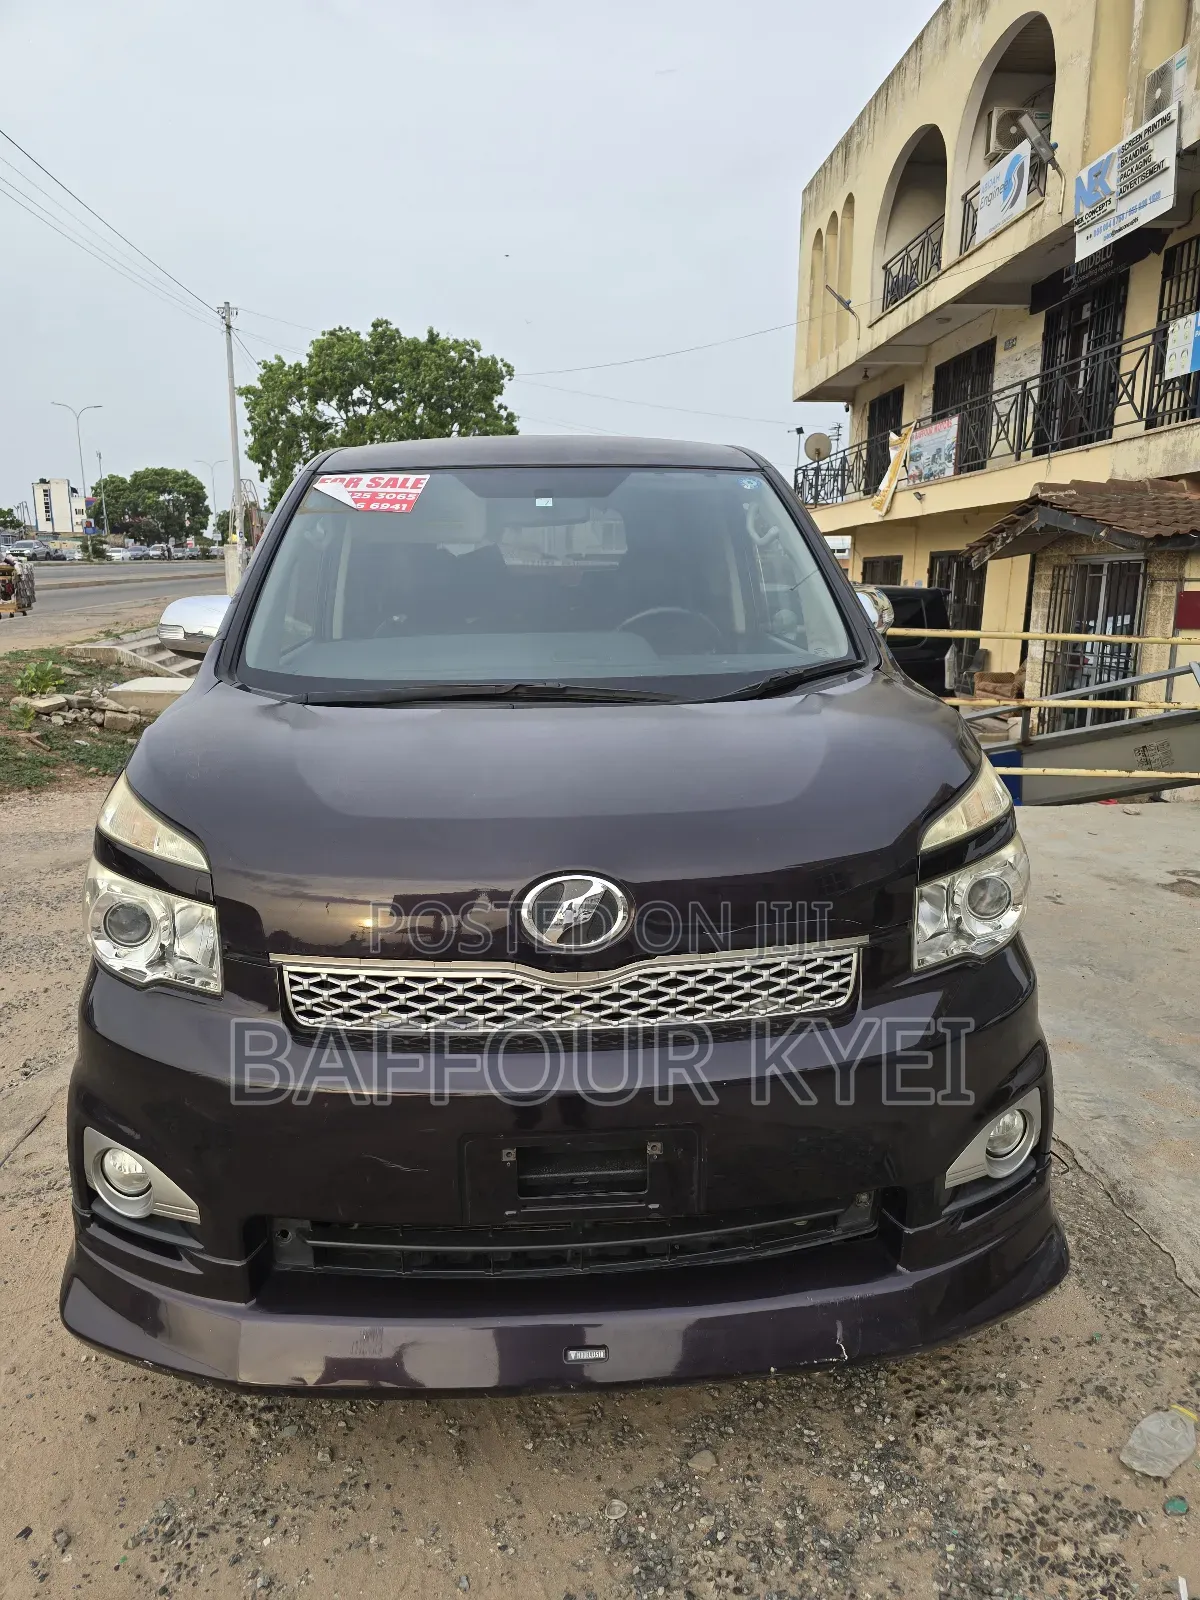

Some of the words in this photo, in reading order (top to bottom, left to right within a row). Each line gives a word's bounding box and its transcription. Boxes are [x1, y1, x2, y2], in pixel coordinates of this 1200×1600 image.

[1121, 133, 1143, 154] SCREEN
[1143, 112, 1172, 139] PRINTING
[1119, 154, 1153, 182] PACKAGING
[1120, 142, 1149, 168] BRANDING
[1074, 152, 1116, 217] NEK
[1118, 159, 1166, 196] ADVERTISEMENT
[1074, 213, 1085, 227] NEK
[1084, 197, 1112, 221] CONCEPTS
[366, 476, 427, 489] SALE
[375, 492, 417, 501] 3065
[369, 502, 408, 511] 6941
